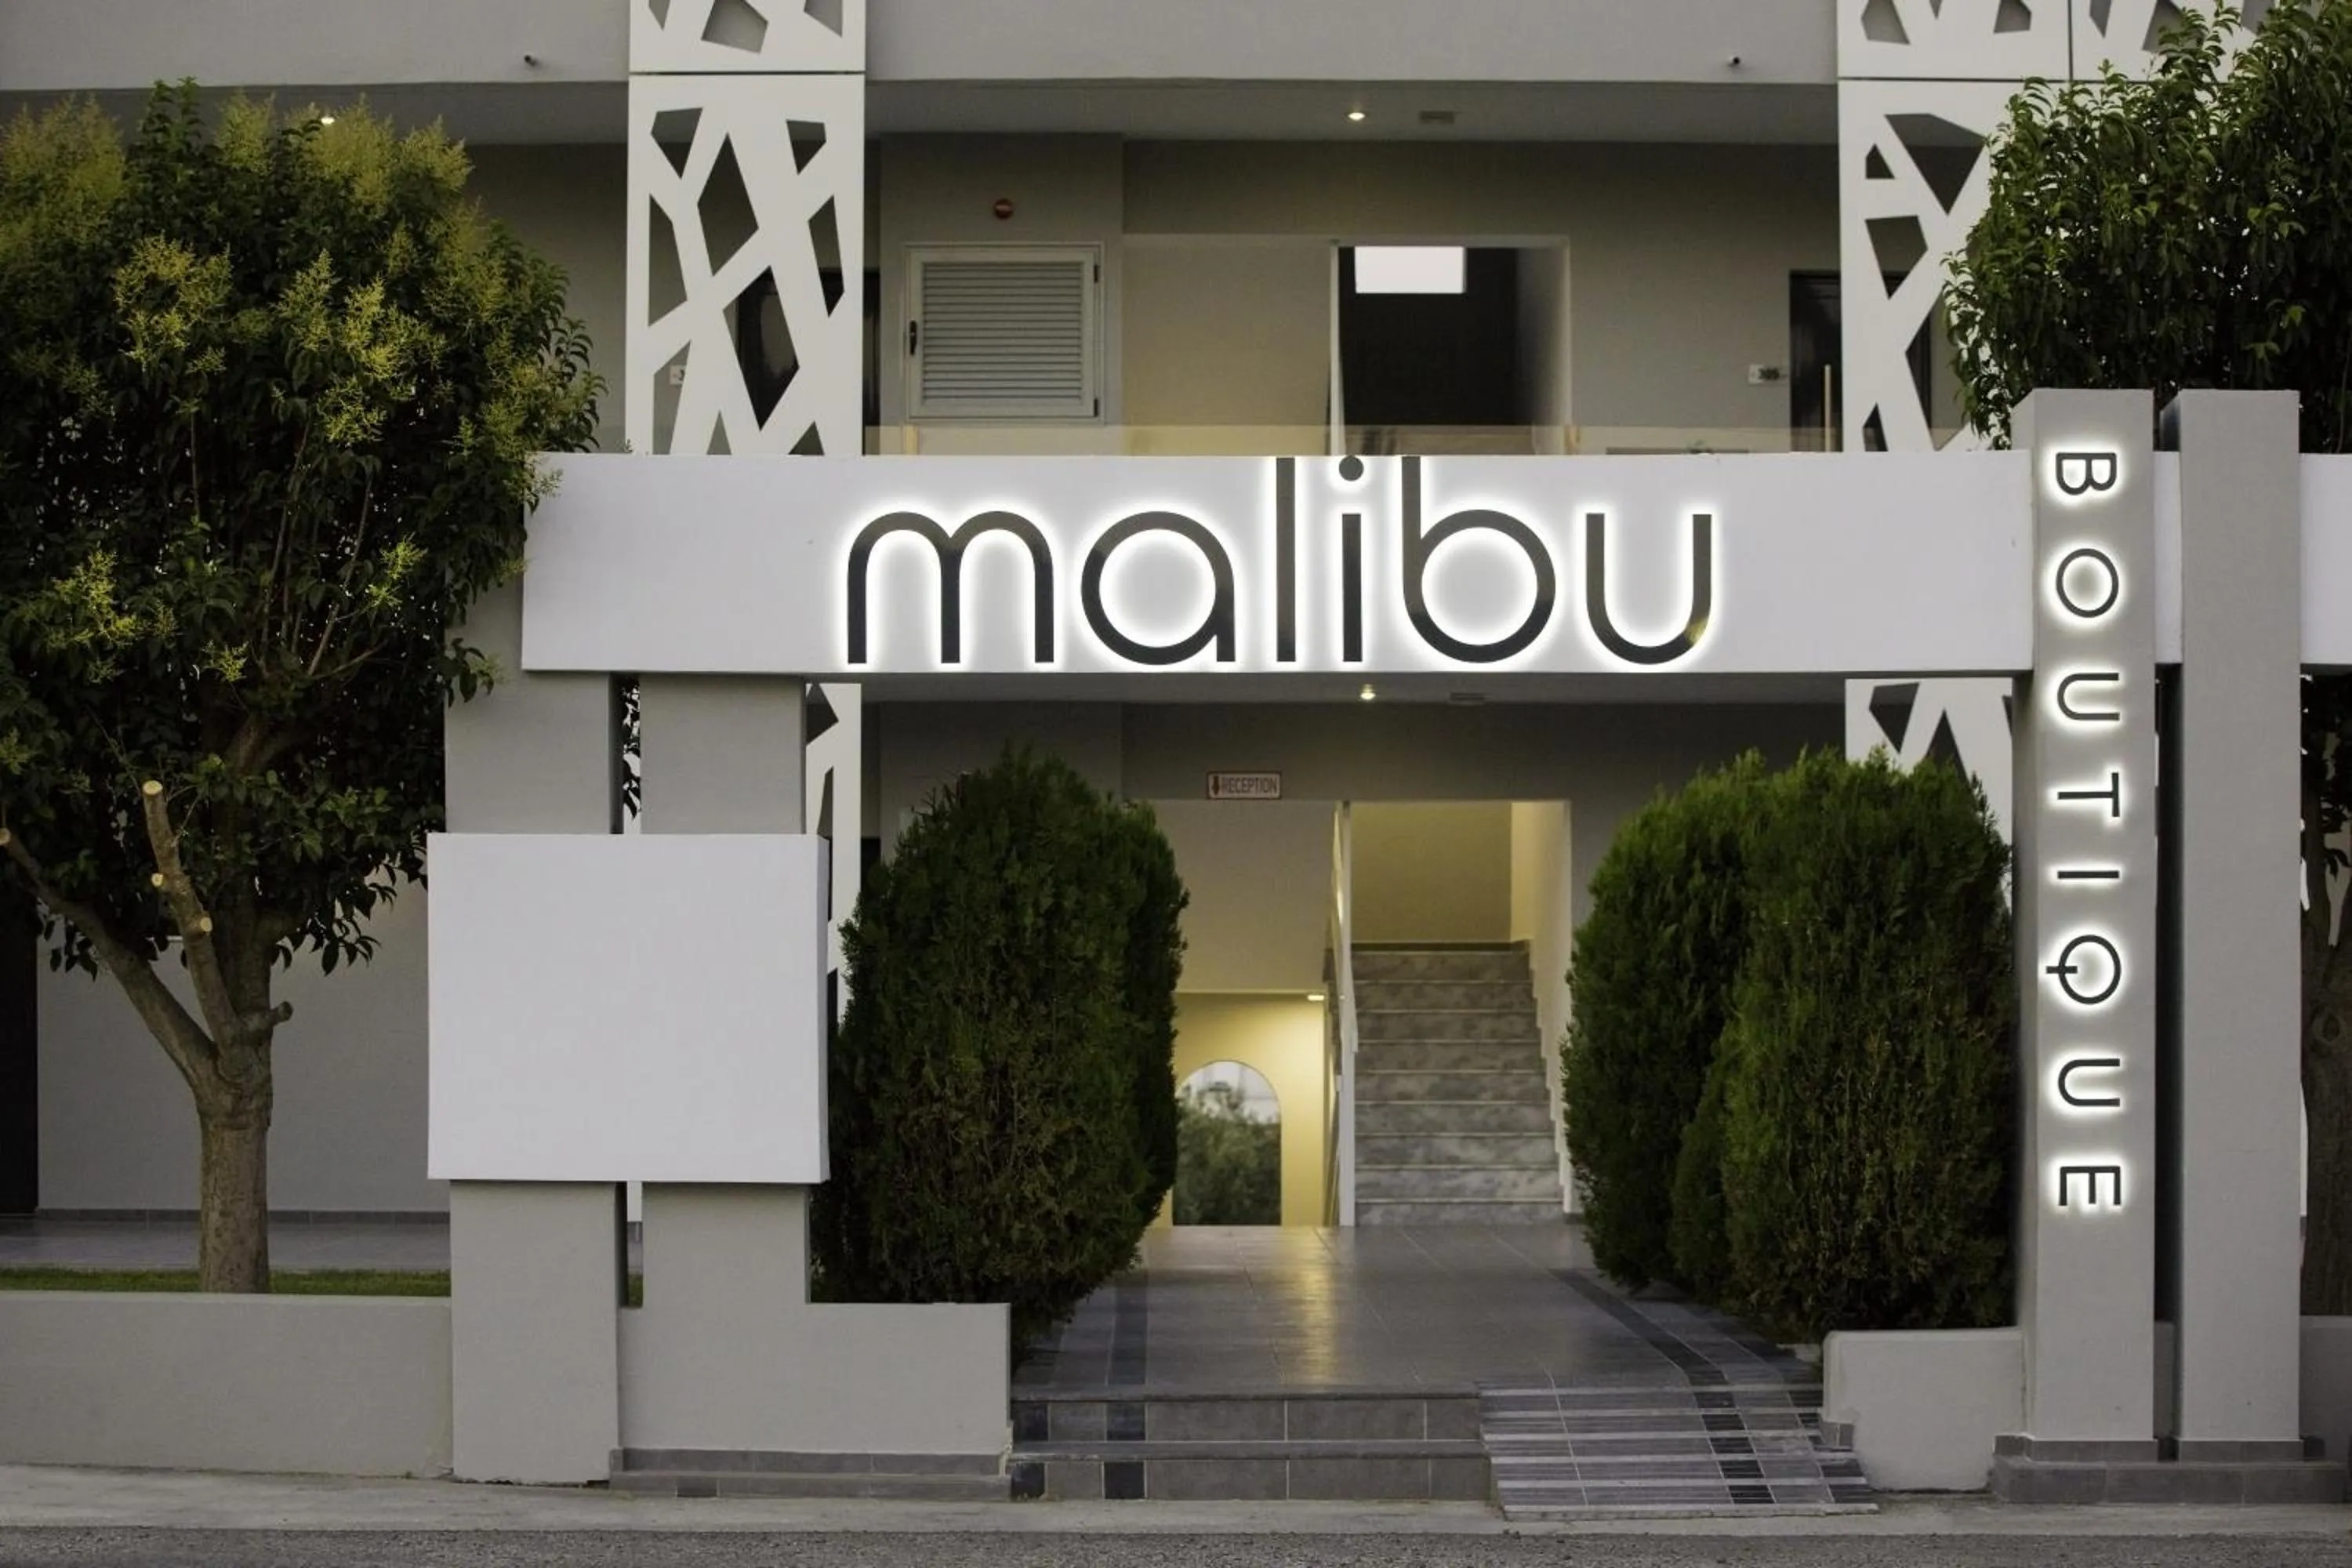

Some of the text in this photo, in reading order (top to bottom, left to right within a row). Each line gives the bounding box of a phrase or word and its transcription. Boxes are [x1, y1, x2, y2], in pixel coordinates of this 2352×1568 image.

[848, 455, 1712, 665] malibu
[1221, 777, 1277, 793] RECEPTION
[2045, 452, 2122, 1206] BOUTIQUE
